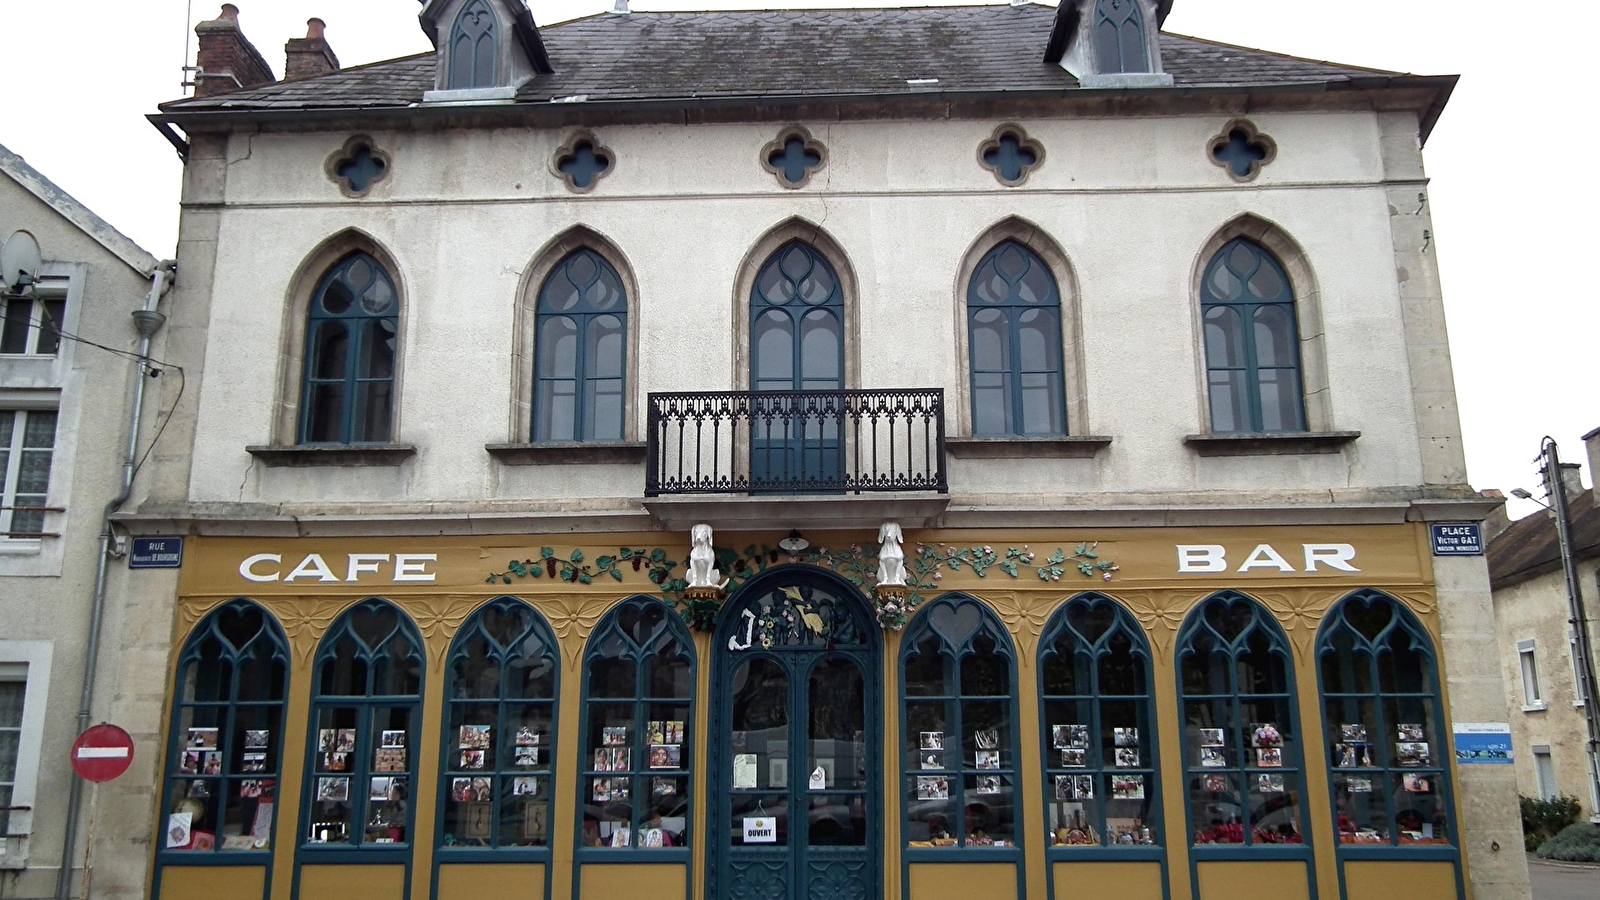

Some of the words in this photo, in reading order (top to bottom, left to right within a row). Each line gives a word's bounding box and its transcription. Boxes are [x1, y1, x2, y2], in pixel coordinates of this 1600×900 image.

[1441, 527, 1471, 535] PLACE
[1437, 536, 1459, 545] VICTOR
[1460, 536, 1477, 544] GAT
[149, 542, 165, 551] RUE
[1175, 543, 1362, 573] BAR
[239, 553, 438, 583] CAFE
[748, 829, 772, 837] OUVERT
